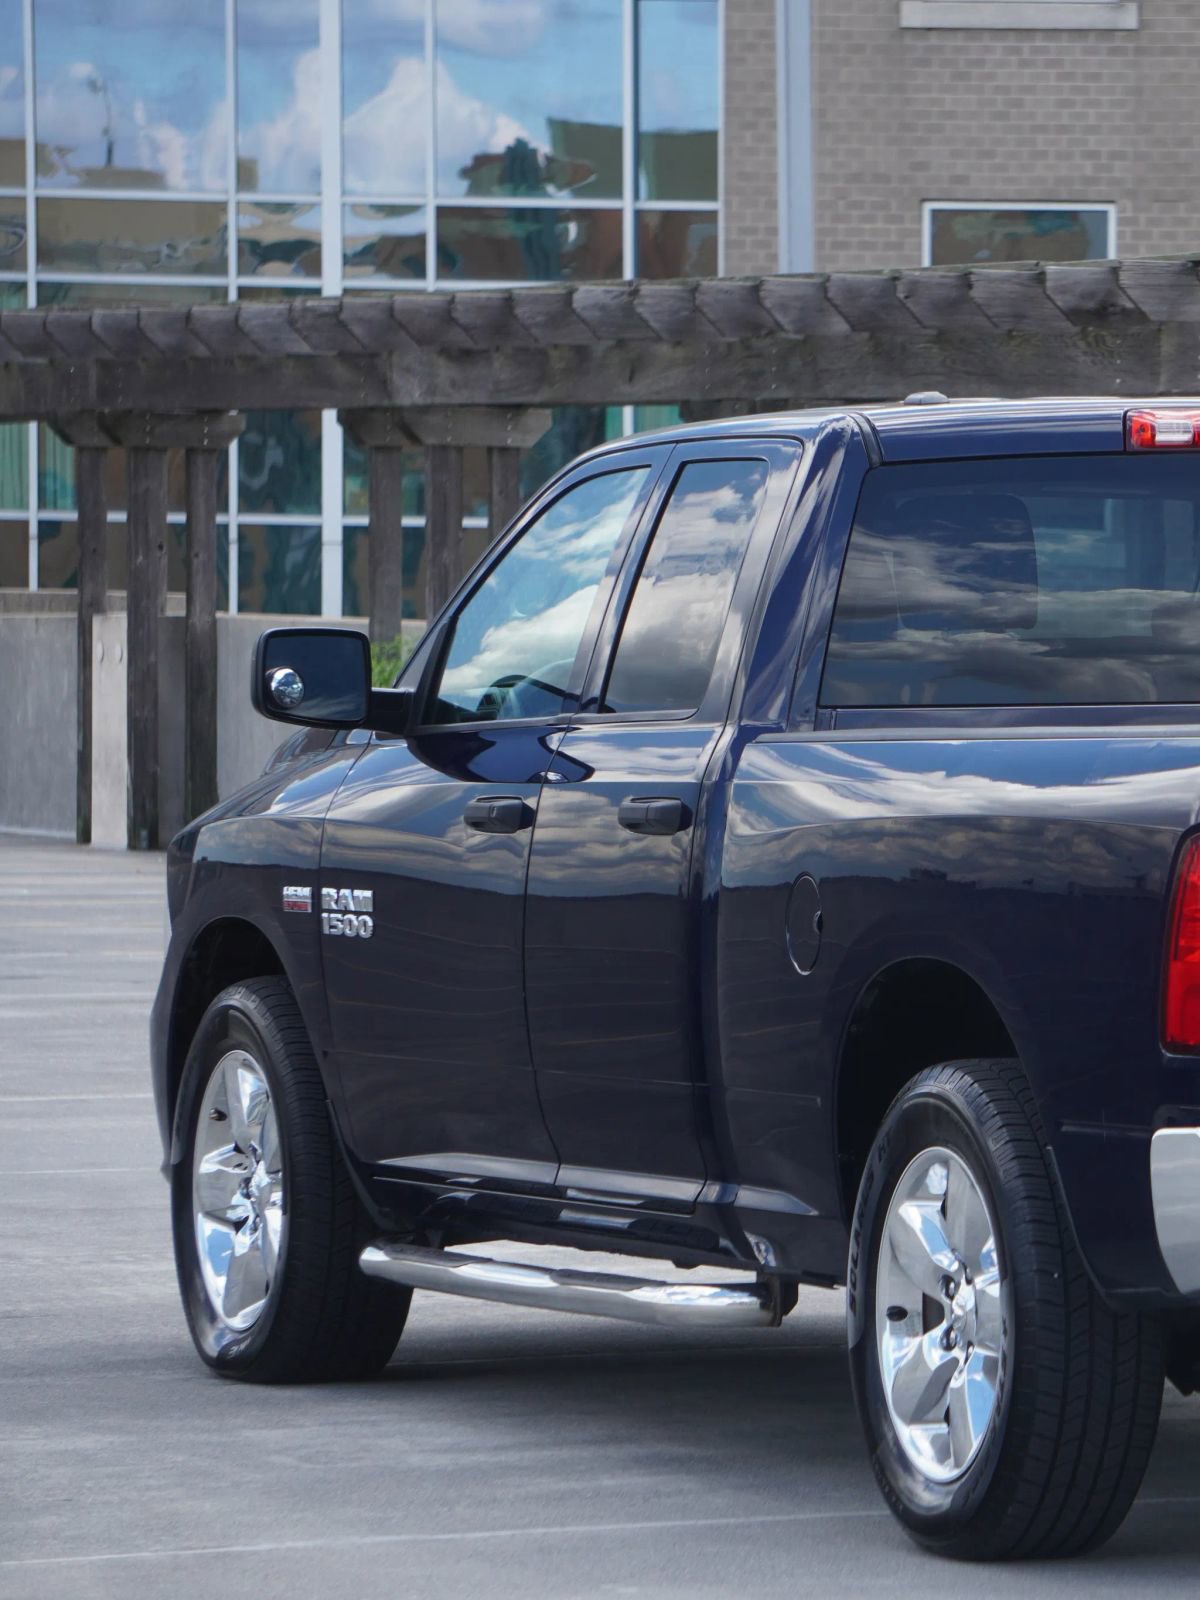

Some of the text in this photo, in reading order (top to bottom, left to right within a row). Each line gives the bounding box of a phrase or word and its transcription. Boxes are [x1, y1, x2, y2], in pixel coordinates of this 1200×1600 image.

[283, 886, 312, 897] HEMI
[321, 887, 373, 912] RAM
[321, 912, 374, 938] 1500
